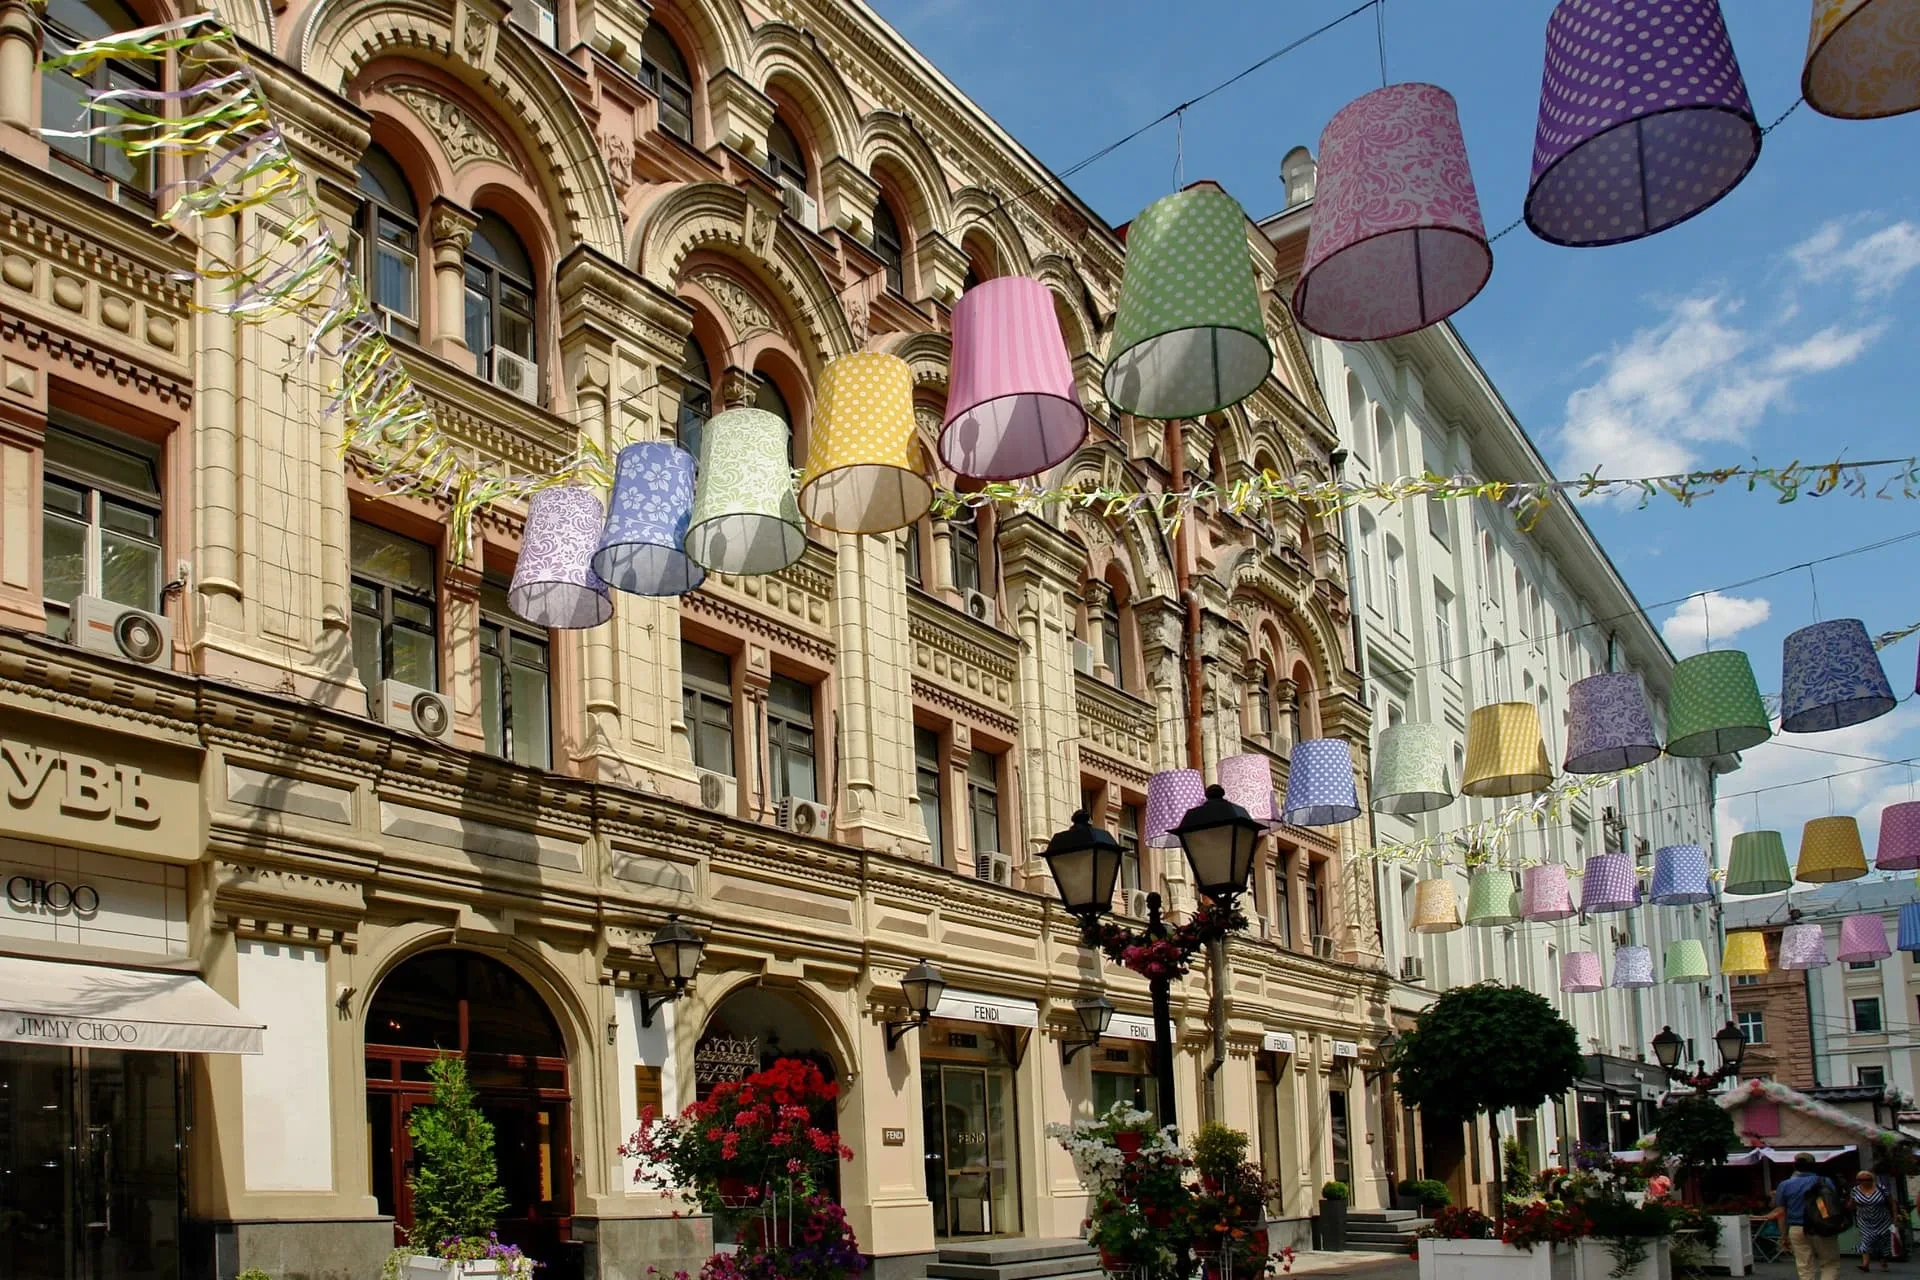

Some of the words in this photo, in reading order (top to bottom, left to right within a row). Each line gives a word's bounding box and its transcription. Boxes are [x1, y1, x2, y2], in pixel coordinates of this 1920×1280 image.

[6, 875, 100, 912] CHOO
[974, 1005, 1000, 1021] FENDI
[16, 1017, 73, 1039] JIMMY
[77, 1022, 138, 1043] CHOO
[1130, 1024, 1149, 1038] FENDI
[1273, 1038, 1288, 1050] FENDI
[886, 1130, 904, 1140] FENDI
